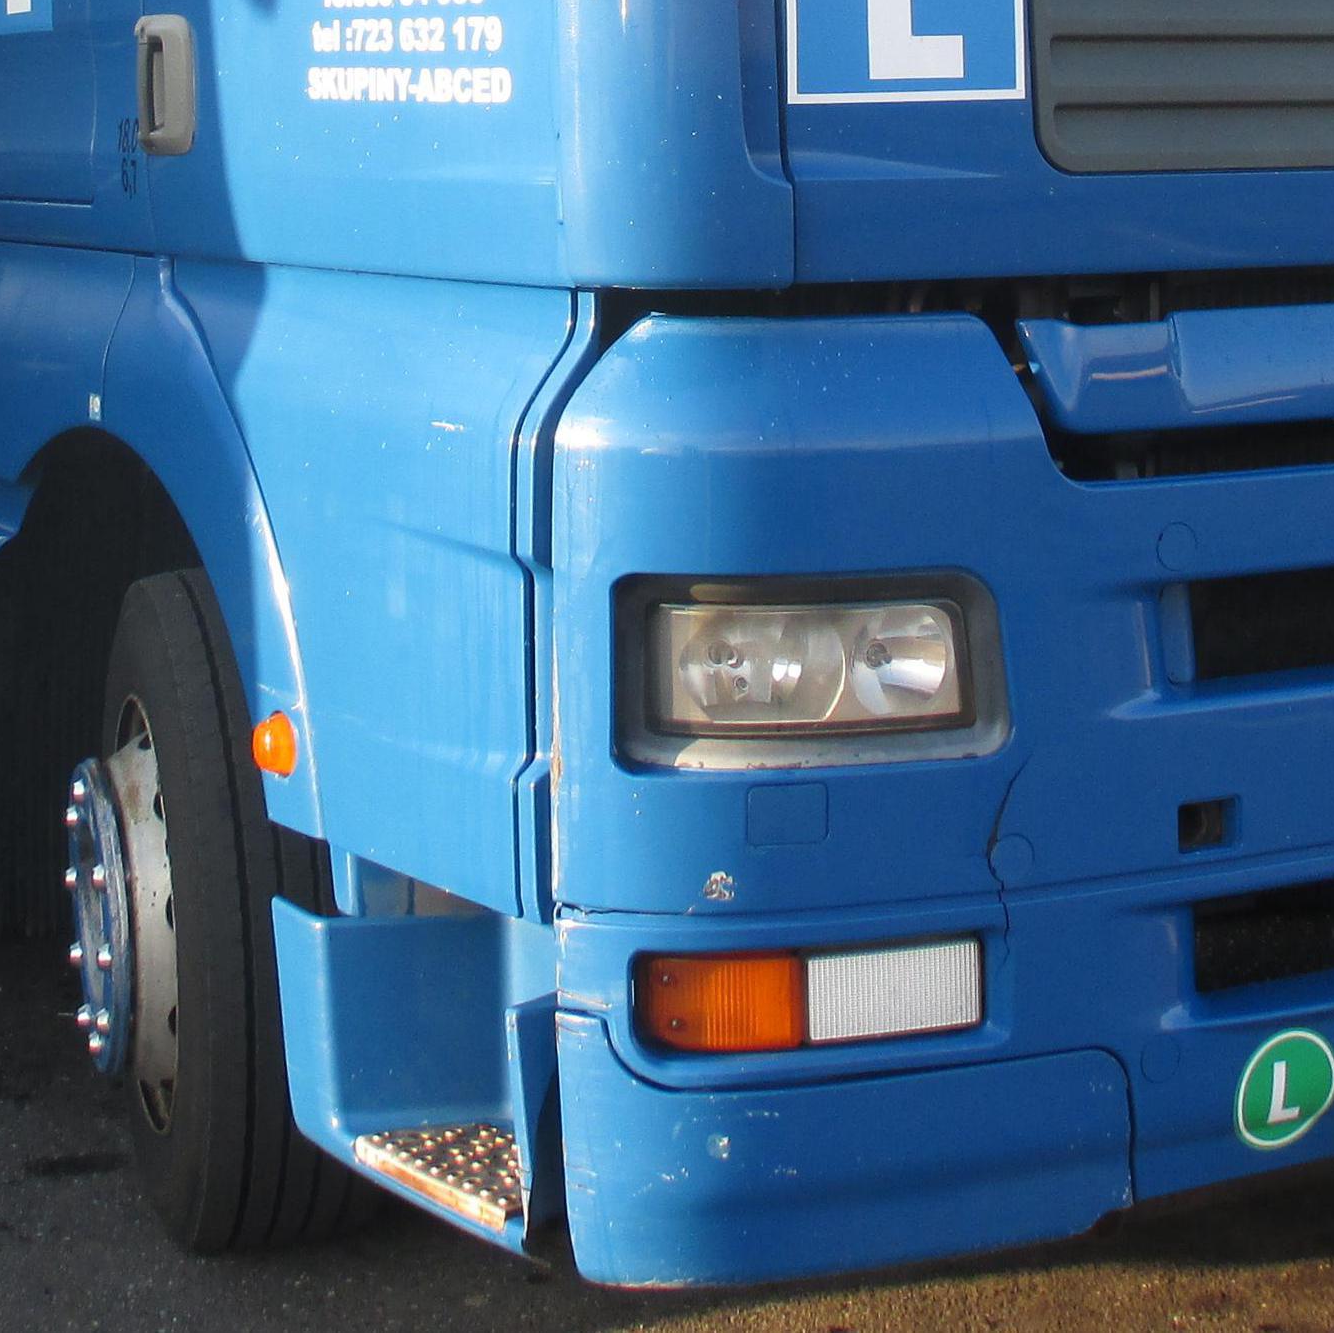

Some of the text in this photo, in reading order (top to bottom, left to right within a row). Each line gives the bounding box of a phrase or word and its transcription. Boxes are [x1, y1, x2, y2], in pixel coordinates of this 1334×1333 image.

[399, 17, 445, 52] 632
[452, 16, 502, 51] 179
[307, 67, 512, 103] SKUPINY-ABCED
[1267, 1060, 1300, 1122] L
